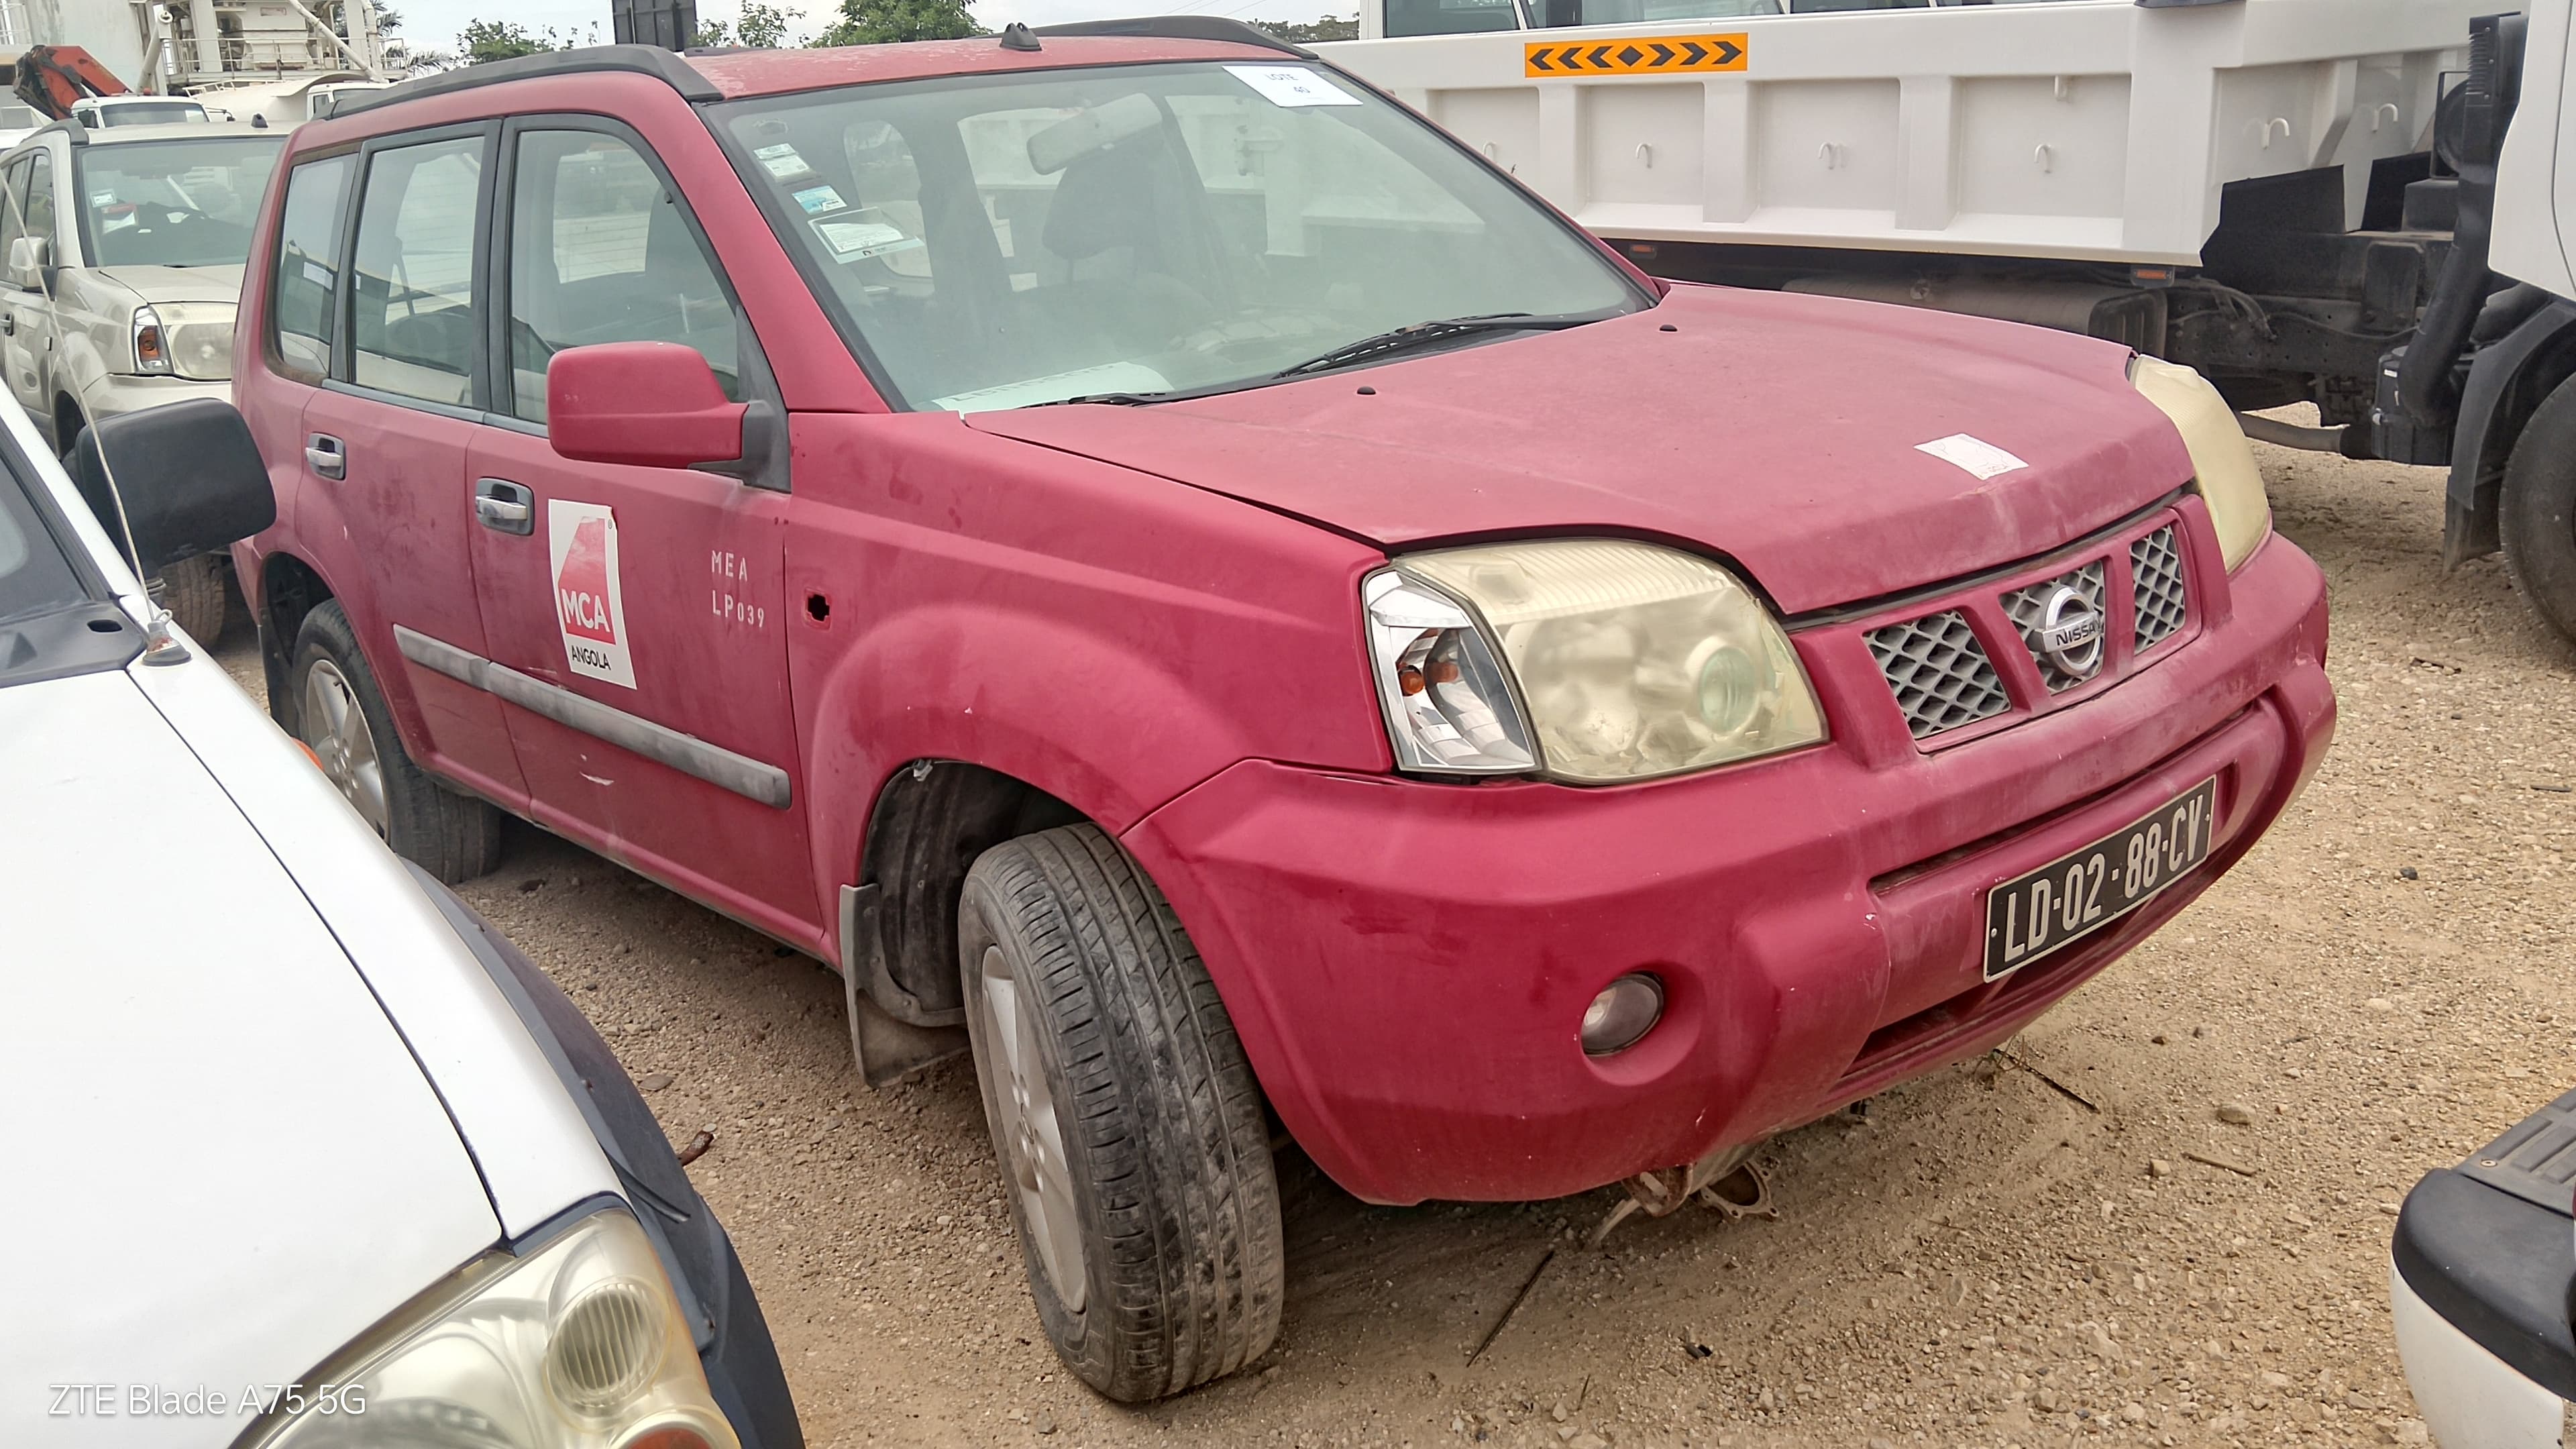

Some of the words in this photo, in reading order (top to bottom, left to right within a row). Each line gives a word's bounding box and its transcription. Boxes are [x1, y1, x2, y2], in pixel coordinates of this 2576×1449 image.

[711, 549, 748, 582] MEA
[561, 588, 611, 633] MCA
[712, 590, 765, 629] LP039
[2055, 619, 2102, 646] NISSAN
[571, 645, 612, 671] ANGOLA
